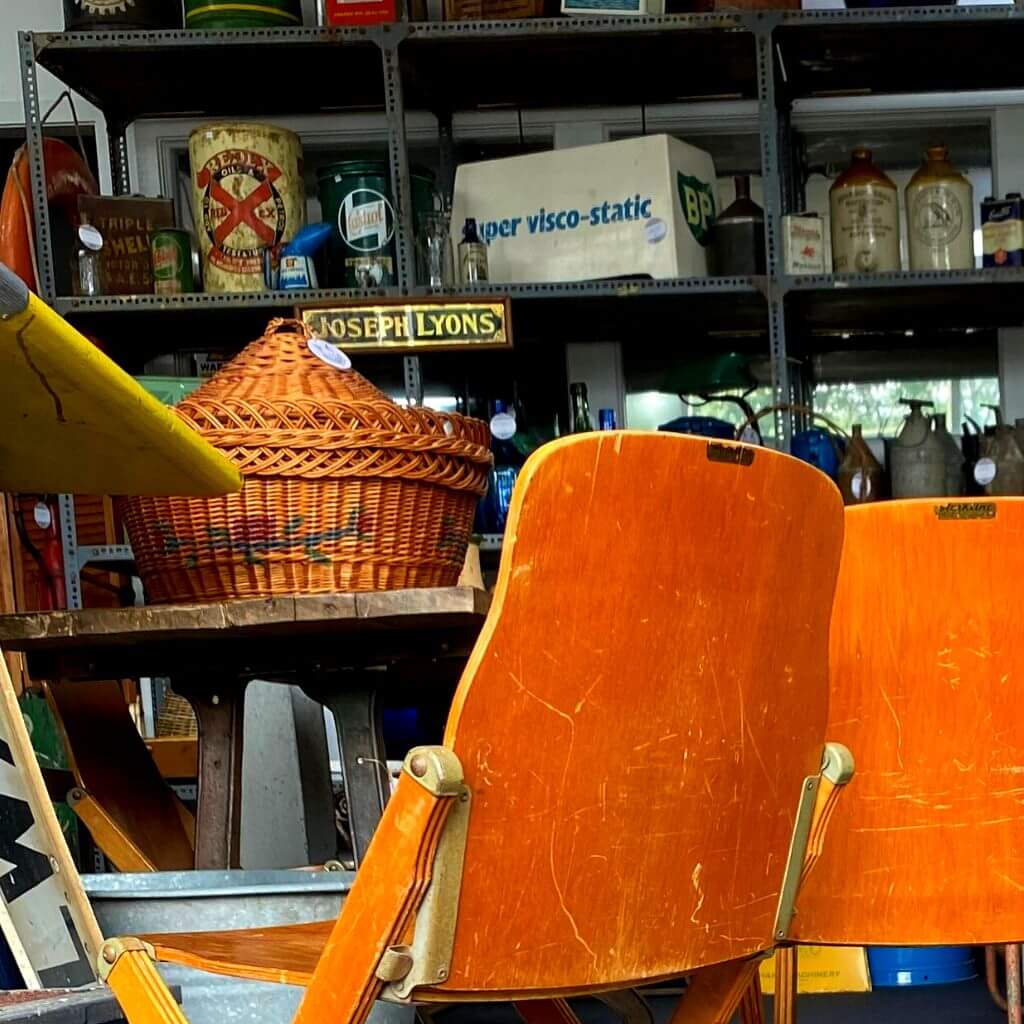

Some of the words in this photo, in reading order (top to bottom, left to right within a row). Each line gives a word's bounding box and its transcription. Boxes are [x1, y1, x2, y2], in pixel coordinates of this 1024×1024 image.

[526, 194, 652, 234] visco-static
[683, 185, 712, 230] BP
[319, 314, 408, 340] JOSEPH
[415, 311, 496, 337] LYONS
